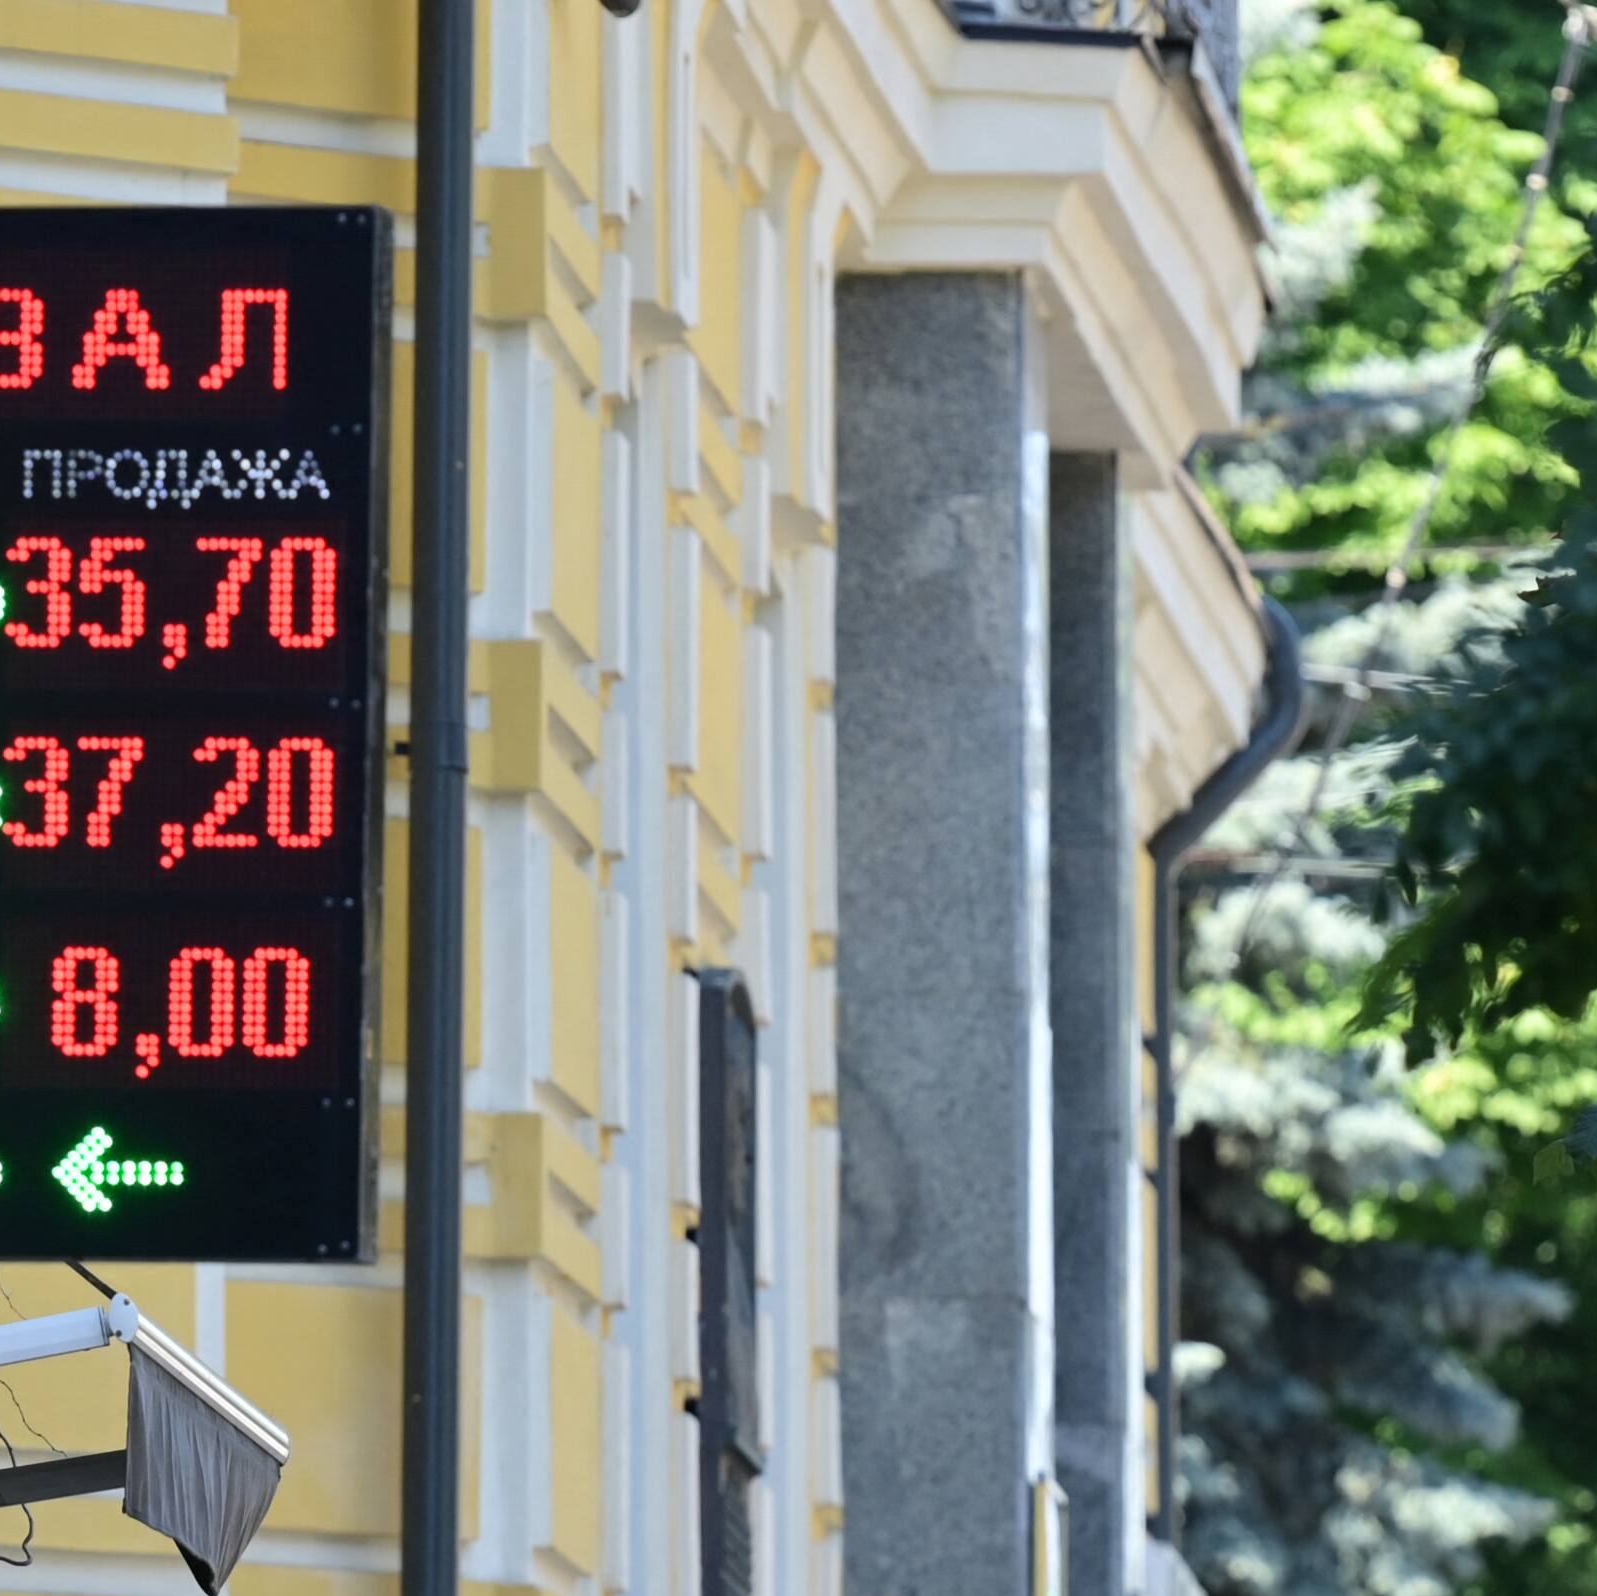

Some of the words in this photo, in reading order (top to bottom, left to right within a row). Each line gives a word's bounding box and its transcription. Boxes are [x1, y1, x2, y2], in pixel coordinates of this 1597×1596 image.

[22, 448, 331, 510] ПРОДАЖА
[4, 535, 338, 670] 35,70
[1, 735, 335, 869] 37,20
[51, 945, 311, 1079] 8,00
